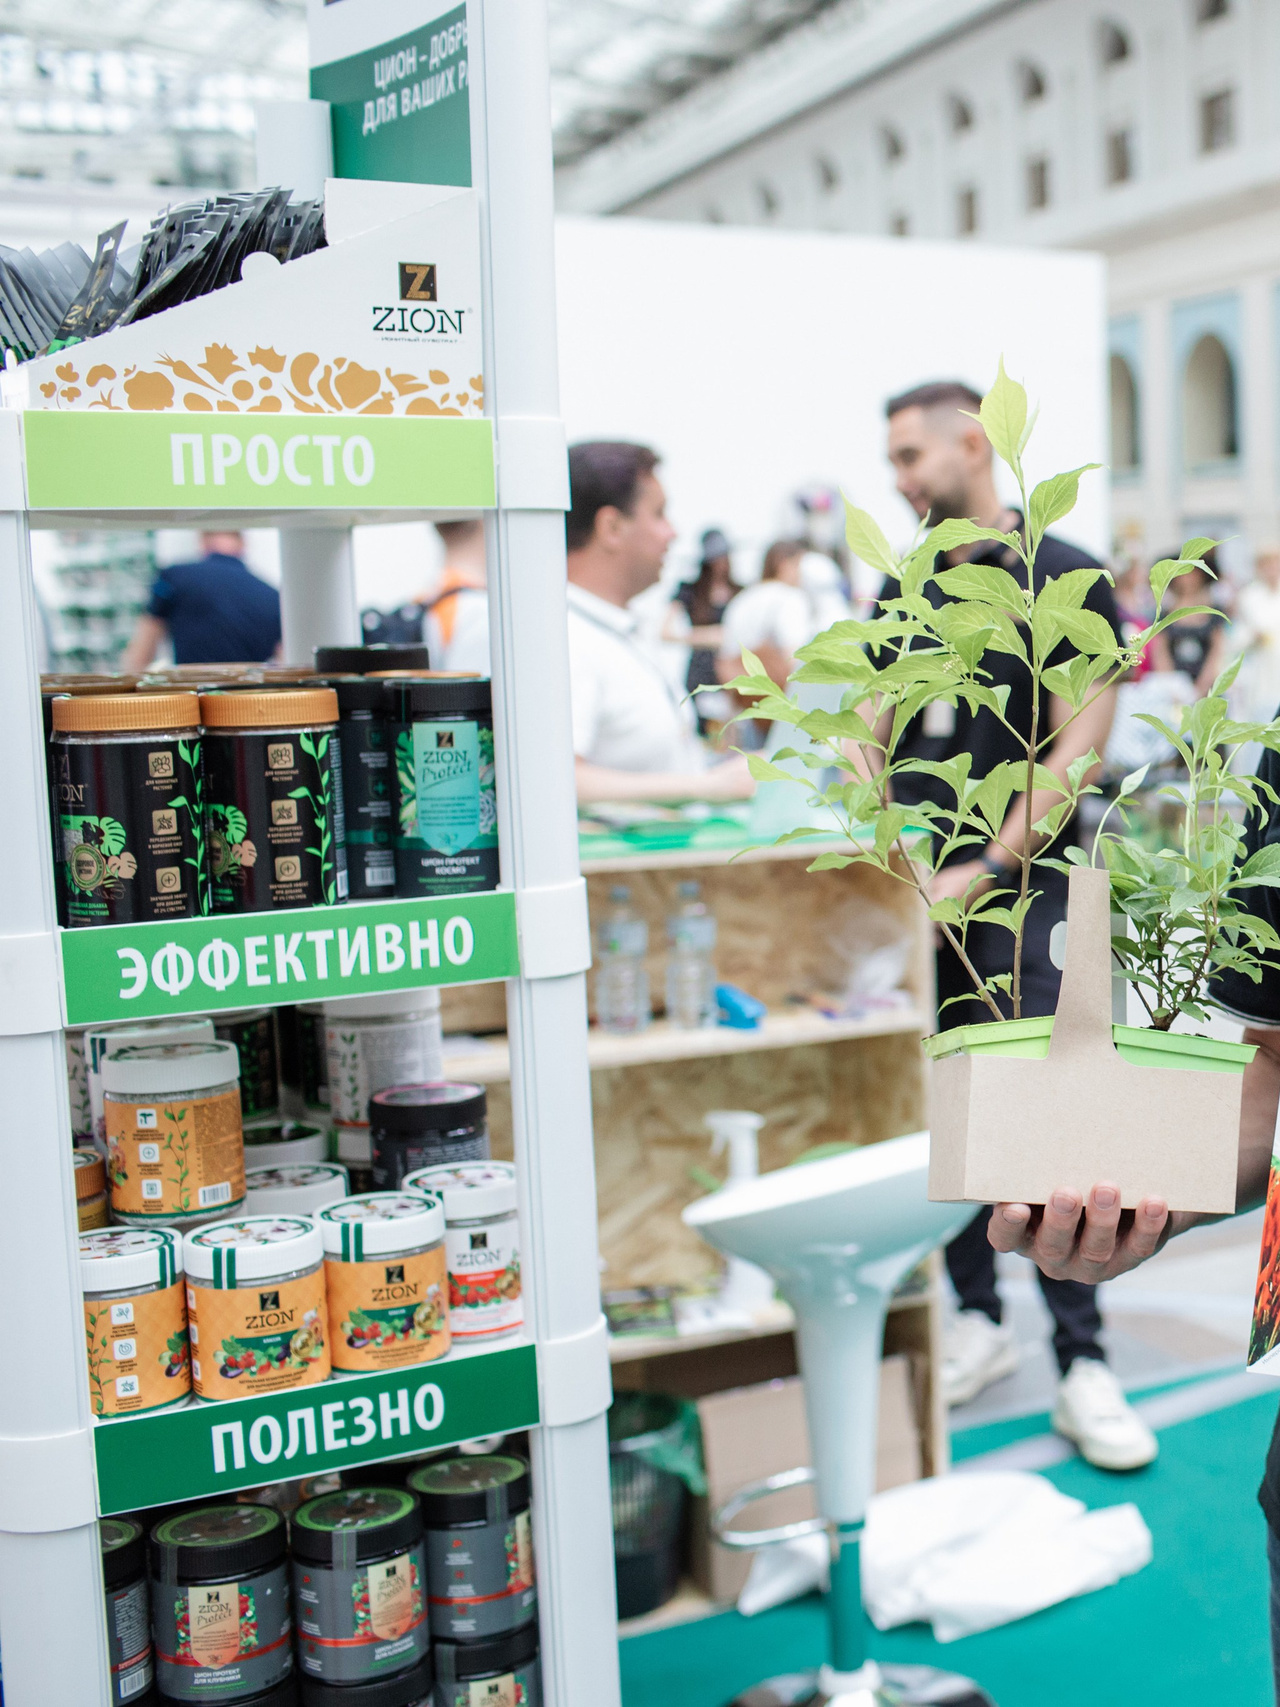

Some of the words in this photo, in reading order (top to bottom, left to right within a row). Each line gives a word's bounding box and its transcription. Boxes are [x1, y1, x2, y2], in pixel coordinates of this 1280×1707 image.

[374, 46, 417, 91] ЦИОН
[362, 92, 398, 136] ДЛЯ
[401, 66, 456, 116] ВАШИХ
[372, 306, 465, 334] ZION
[170, 433, 375, 486] ПРОСТО
[422, 759, 472, 783] Protect
[423, 751, 468, 764] ZION
[116, 916, 475, 999] ЭФФЕКТИВНО
[371, 1283, 418, 1301] ZION
[245, 1310, 294, 1330] ZION
[211, 1383, 445, 1473] ПОЛЕЗНО
[198, 1603, 230, 1614] ZION
